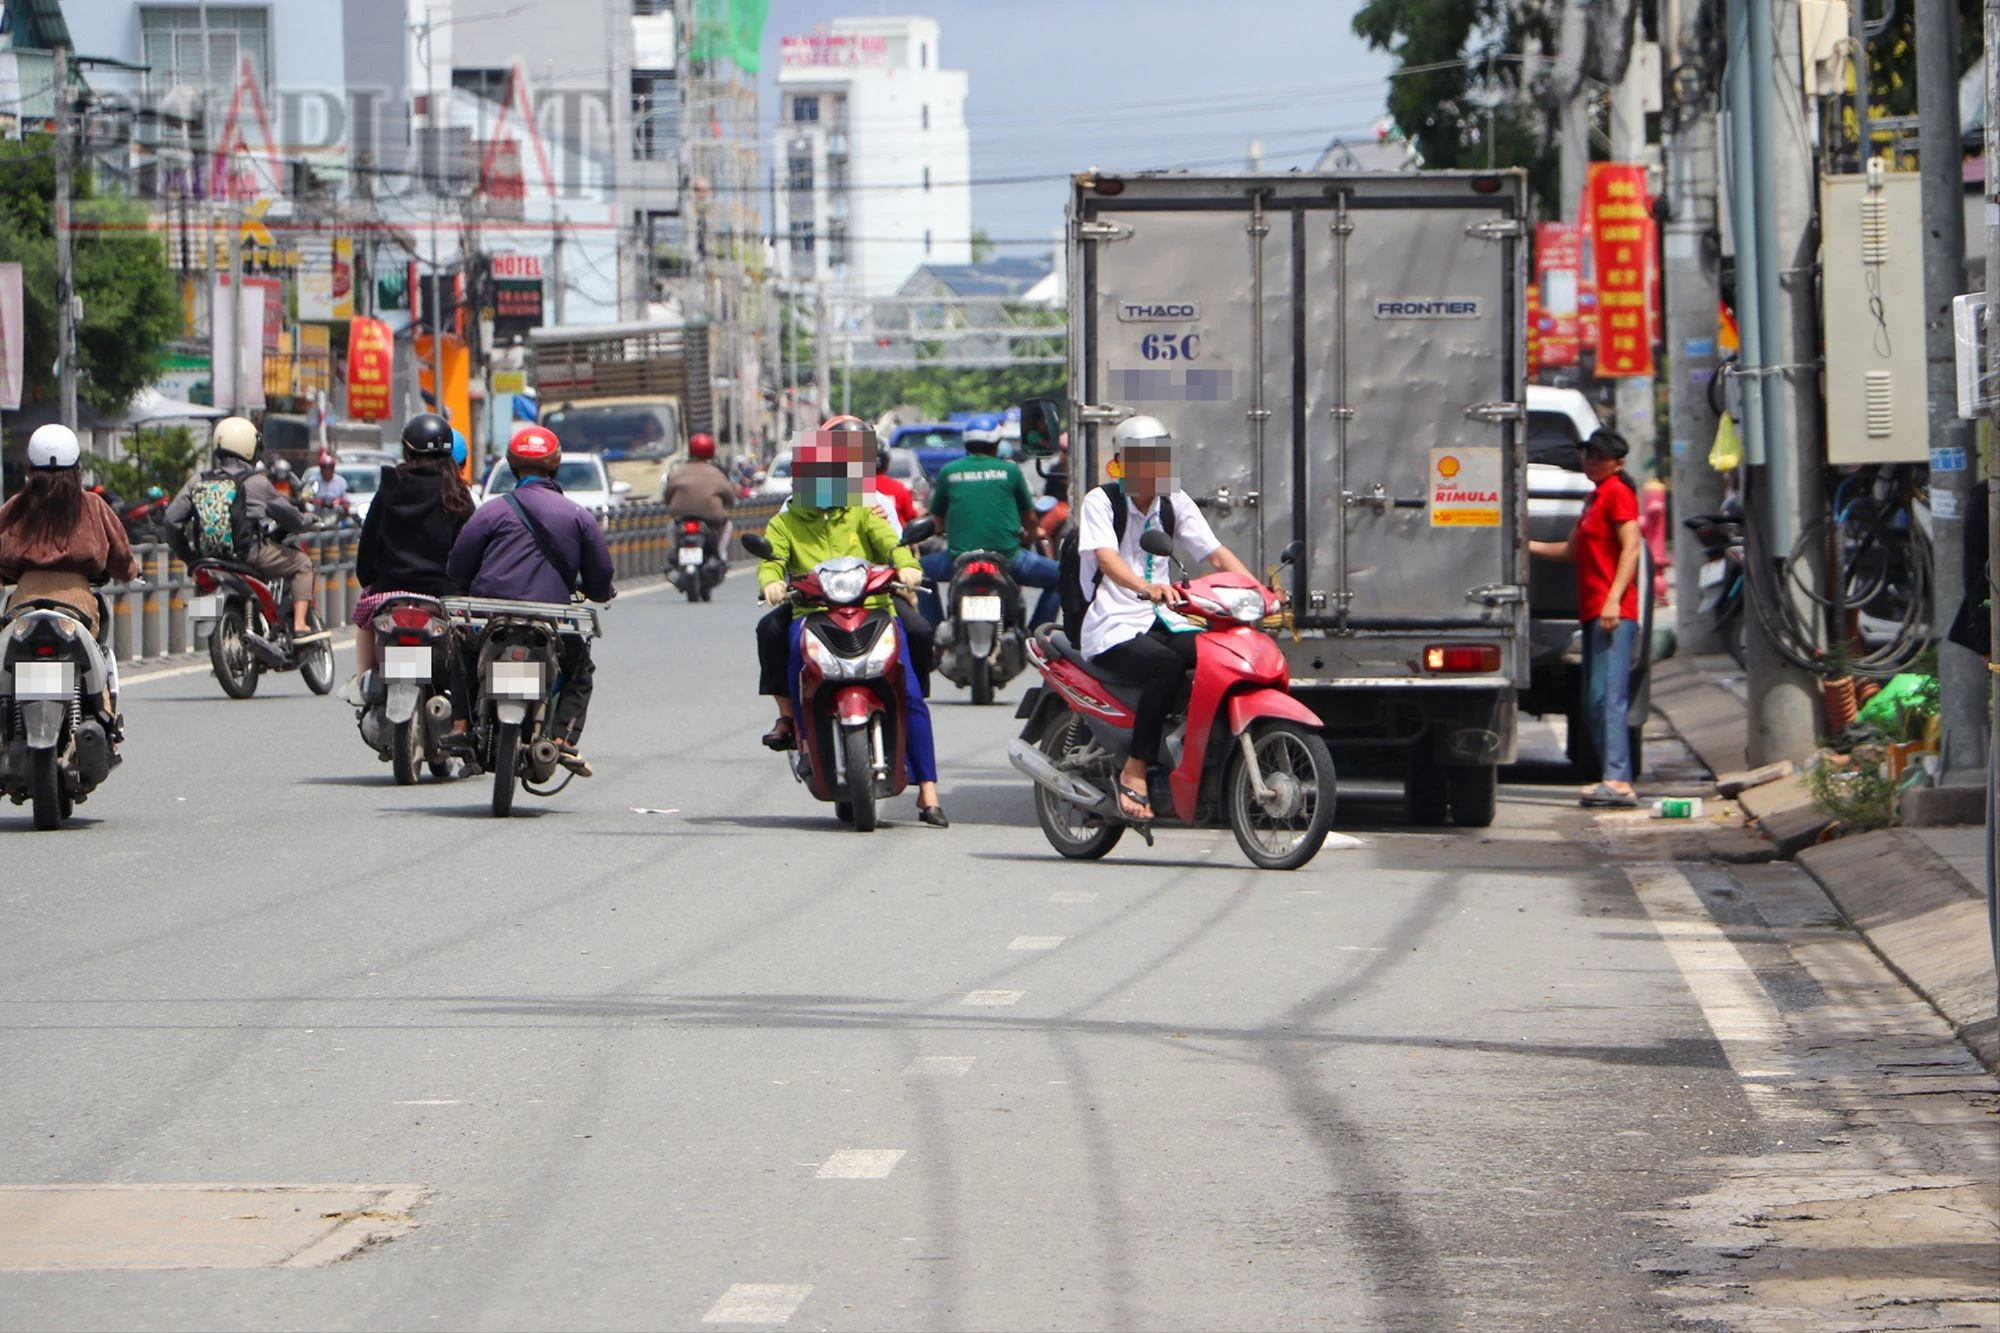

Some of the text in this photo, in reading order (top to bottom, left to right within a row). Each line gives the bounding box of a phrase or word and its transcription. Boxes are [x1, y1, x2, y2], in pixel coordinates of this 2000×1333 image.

[1124, 304, 1195, 317] THACO
[1377, 302, 1477, 314] FRONTIER
[1141, 332, 1200, 361] 65C
[1435, 491, 1498, 502] RIMULA
